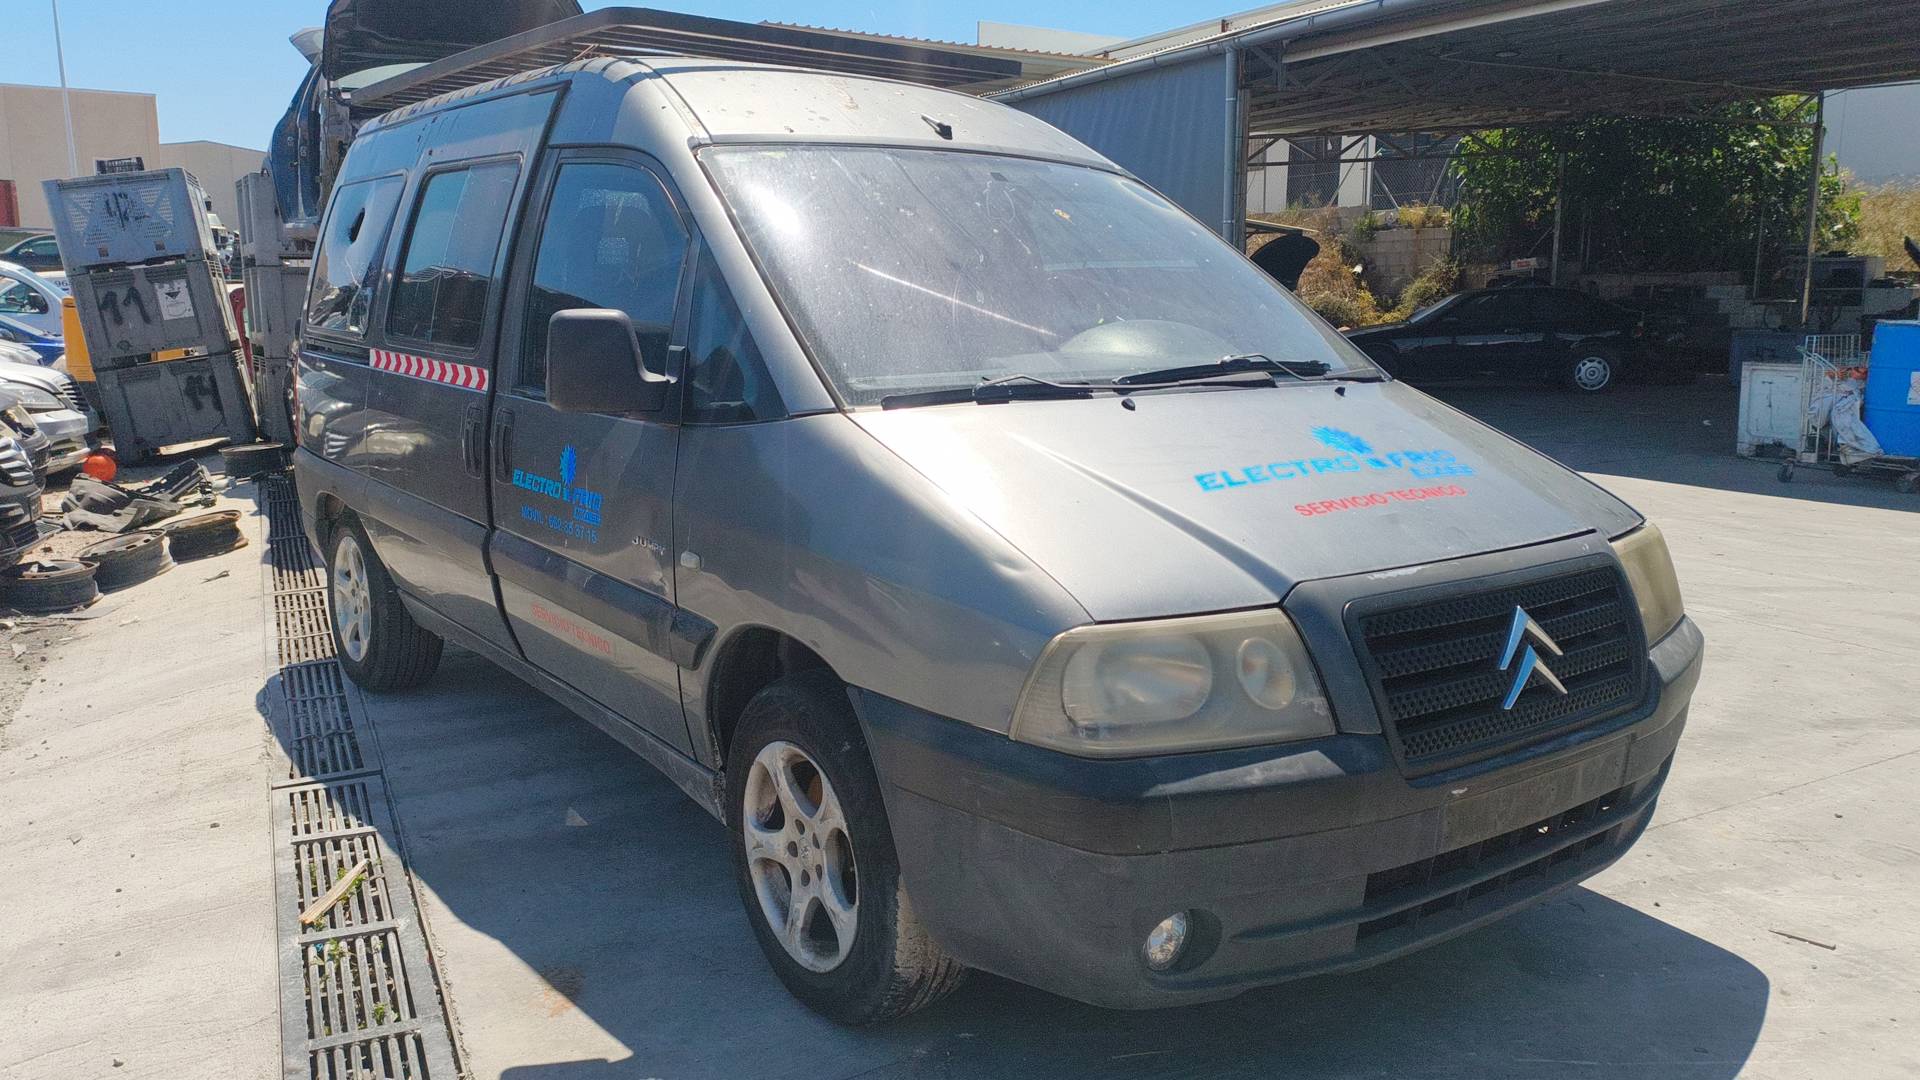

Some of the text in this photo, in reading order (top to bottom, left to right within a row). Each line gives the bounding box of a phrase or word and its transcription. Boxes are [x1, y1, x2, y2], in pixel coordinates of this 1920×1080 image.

[512, 468, 561, 499] ELECTRO
[1194, 455, 1361, 492] ELECTRO
[1294, 484, 1468, 517] SERVICIO TECNICO
